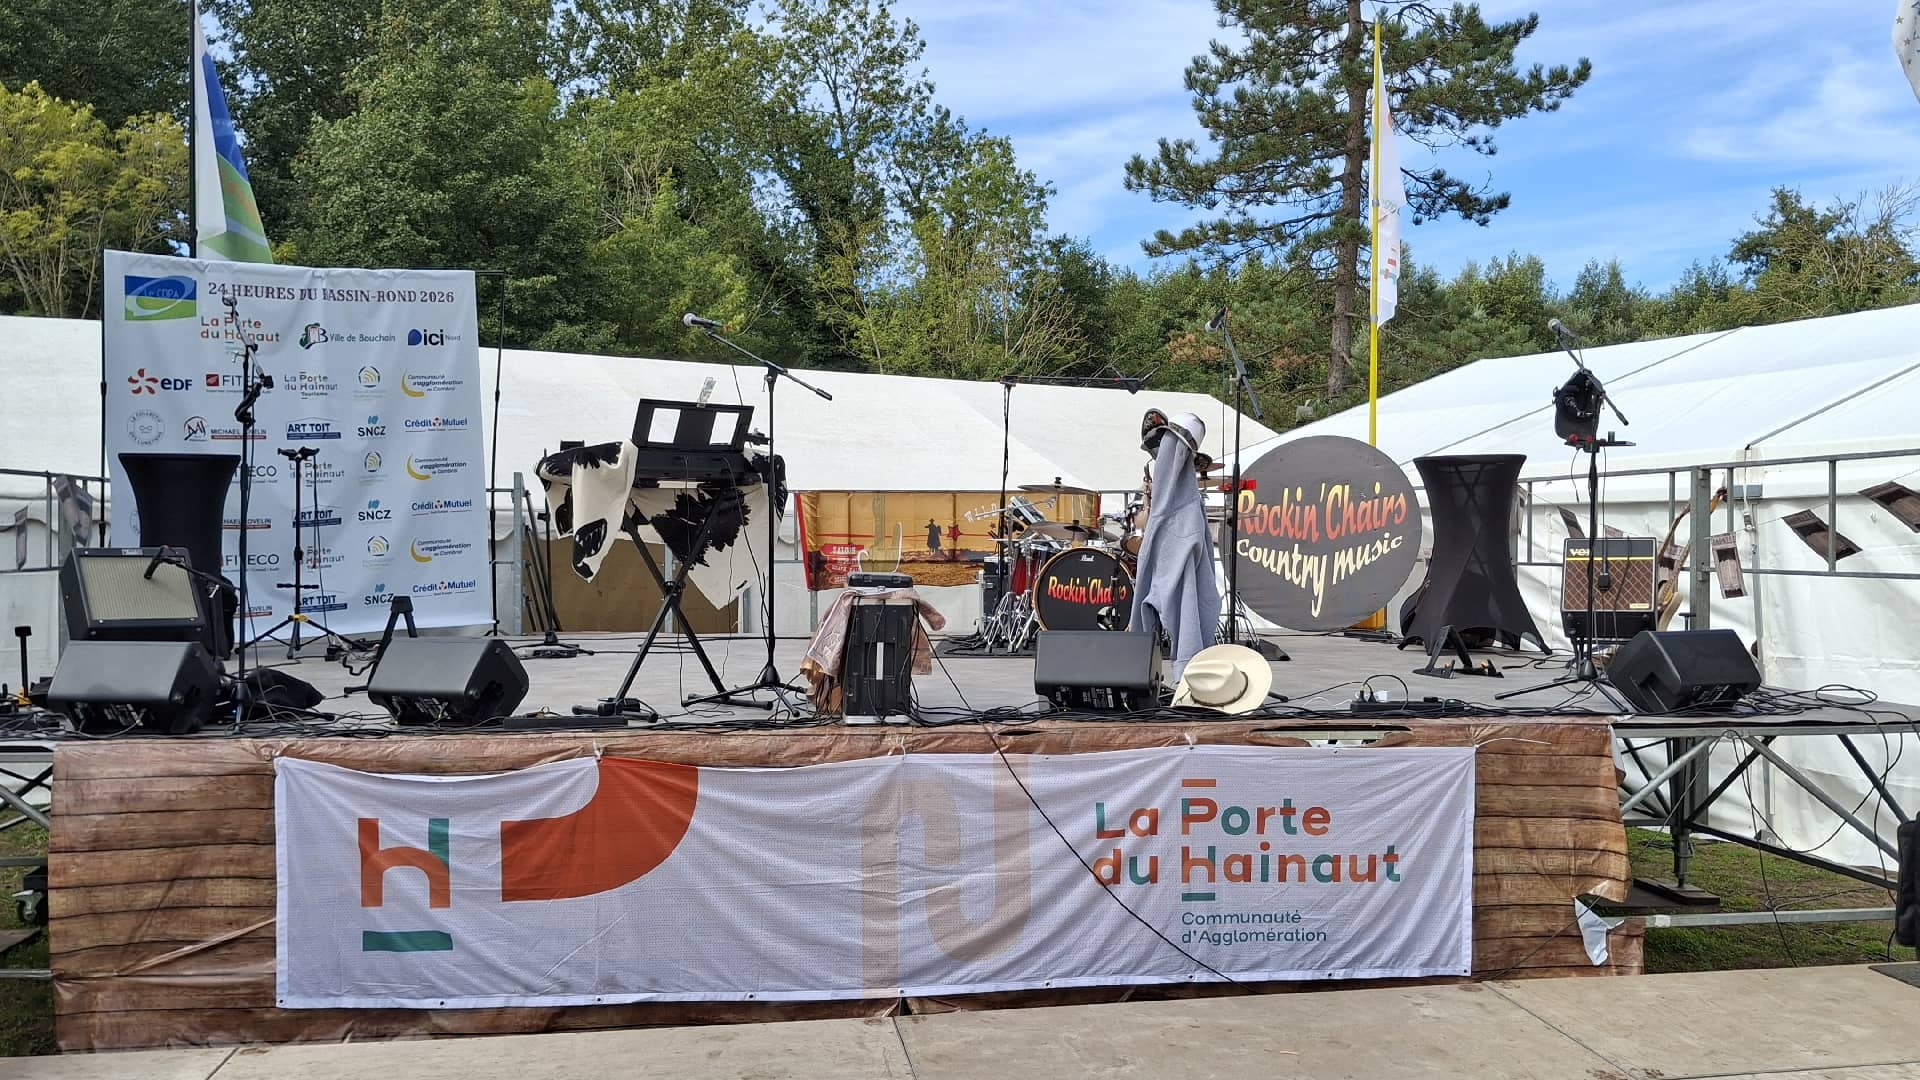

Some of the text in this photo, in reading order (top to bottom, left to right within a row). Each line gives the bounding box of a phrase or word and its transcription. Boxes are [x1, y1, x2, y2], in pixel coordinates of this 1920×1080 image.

[209, 282, 227, 295] 24
[232, 284, 295, 300] HEURES
[420, 291, 454, 303] 2026
[201, 316, 262, 329] La Prte
[200, 329, 219, 339] du
[330, 333, 345, 342] Ville
[347, 333, 357, 342] de
[359, 333, 396, 342] Bouchain
[423, 329, 444, 346] ici
[284, 374, 328, 383] La Porte
[288, 423, 330, 432] ART TOIT
[405, 418, 468, 428] Crédit Mutuel
[357, 426, 386, 437] SNCZ
[412, 499, 472, 511] Crédit Mutuel
[358, 509, 393, 521] SNCZ
[225, 554, 279, 566] FIECO
[413, 580, 476, 593] Crédit Mutuel
[364, 593, 394, 606] SNCZ
[1095, 797, 1331, 839] La Porte
[1094, 841, 1401, 885] du Hainaut
[1181, 909, 1301, 926] Communauté
[1181, 927, 1327, 946] d'Agglomération
